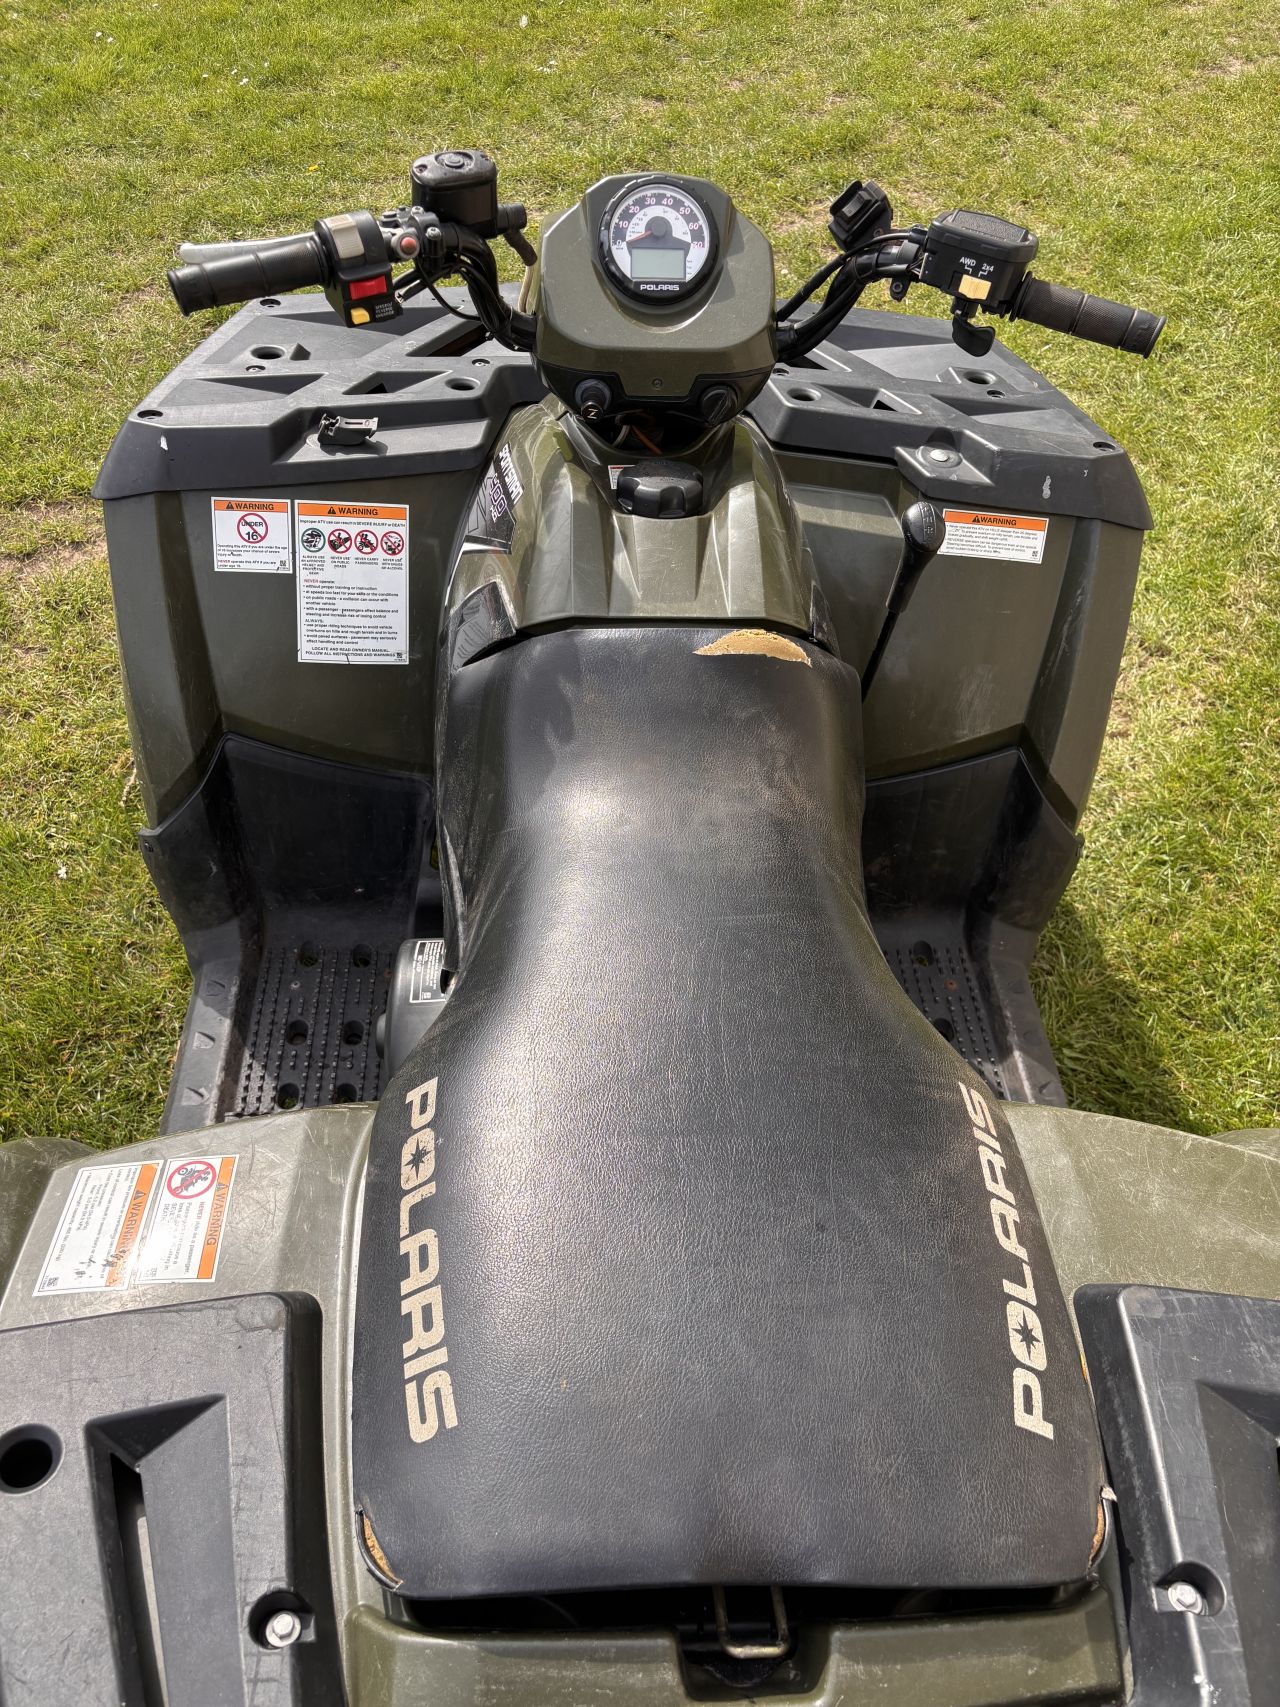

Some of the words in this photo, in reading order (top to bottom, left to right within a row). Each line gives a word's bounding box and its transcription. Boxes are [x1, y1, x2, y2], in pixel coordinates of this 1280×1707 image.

[629, 206, 640, 214] 20
[679, 207, 691, 215] 50
[618, 220, 629, 228] 10
[688, 222, 700, 230] 60
[959, 256, 976, 266] AWD
[982, 262, 994, 272] 2x4
[499, 442, 524, 505] SPORTSMAN
[235, 502, 274, 511] WARNING
[338, 507, 378, 516] WARNING
[980, 515, 1017, 526] WARNING
[245, 531, 259, 541] 16
[205, 1192, 225, 1246] WARNING
[400, 1077, 458, 1444] POLARIS
[958, 1081, 1054, 1441] POLARIS
